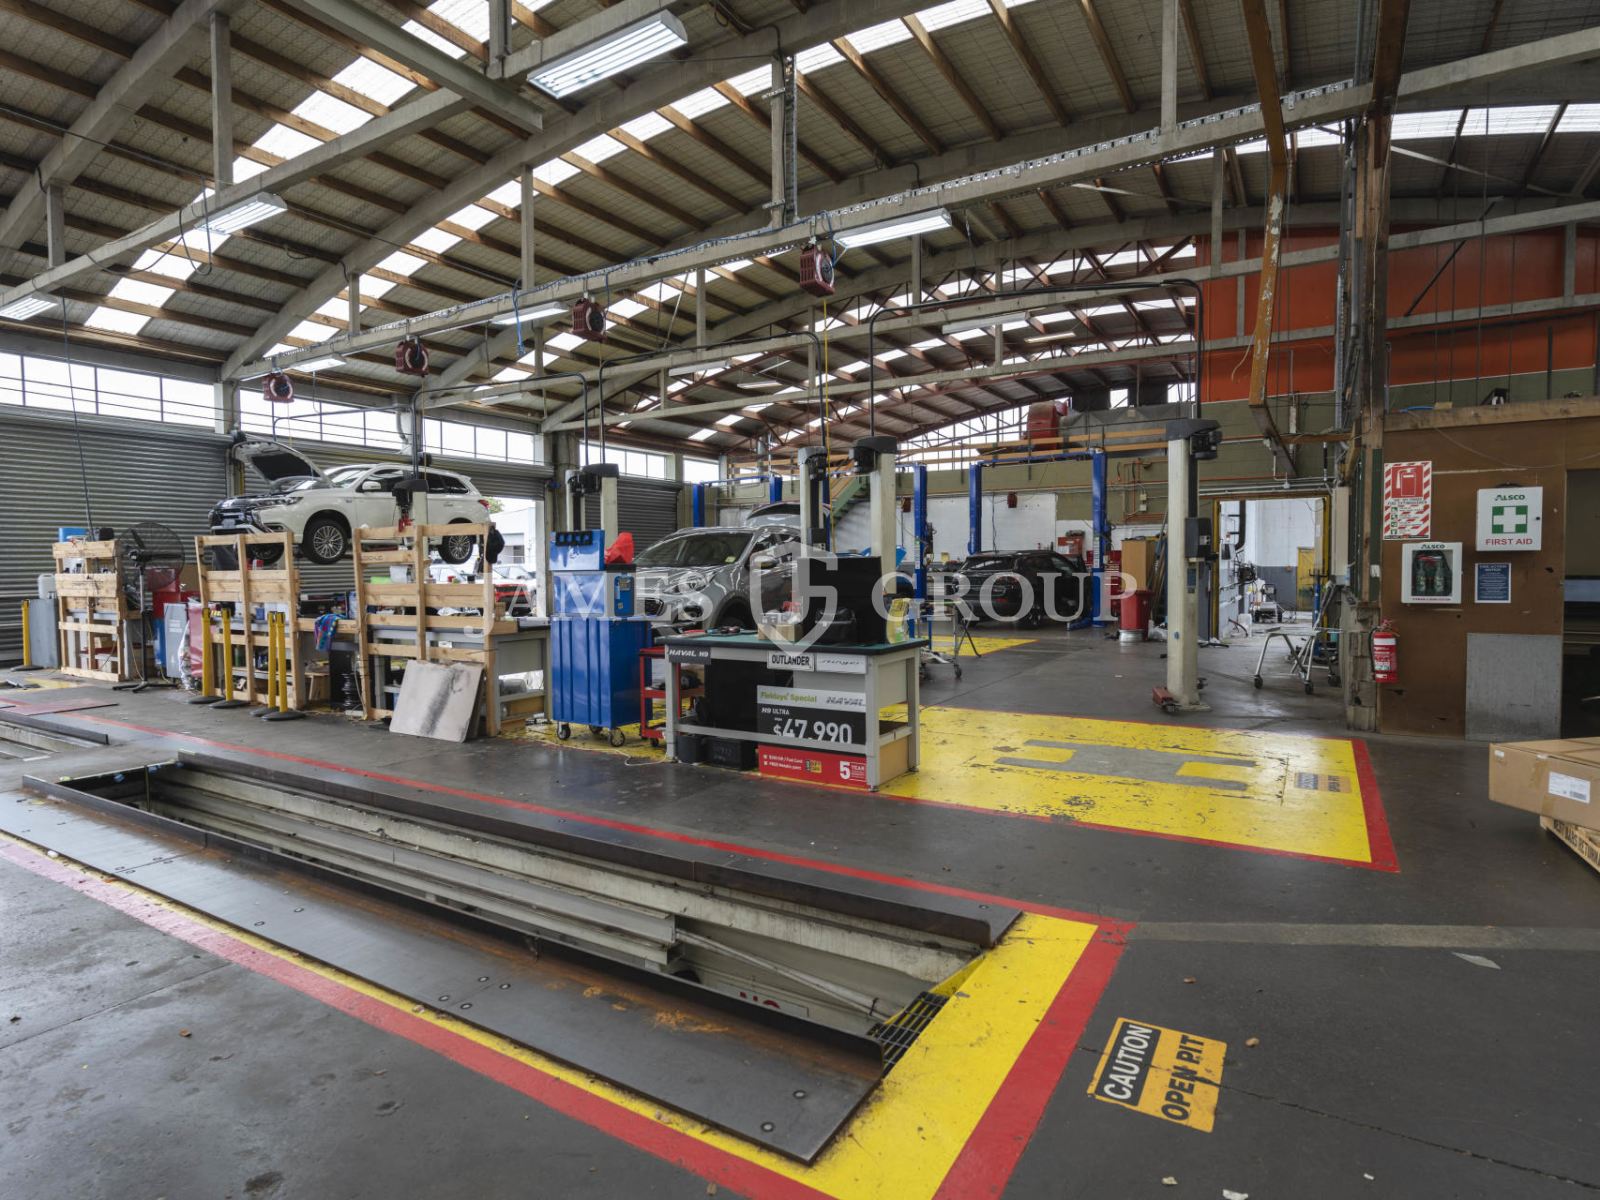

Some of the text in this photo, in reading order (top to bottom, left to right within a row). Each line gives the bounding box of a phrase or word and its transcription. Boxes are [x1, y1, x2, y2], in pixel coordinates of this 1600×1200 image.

[1485, 538, 1513, 546] FIRST
[669, 648, 696, 658] HAVAL
[771, 654, 810, 667] OUTLANDER
[840, 761, 851, 779] 5
[1103, 1024, 1153, 1100] CAUTION
[1161, 1034, 1205, 1121] OPEN PIT
